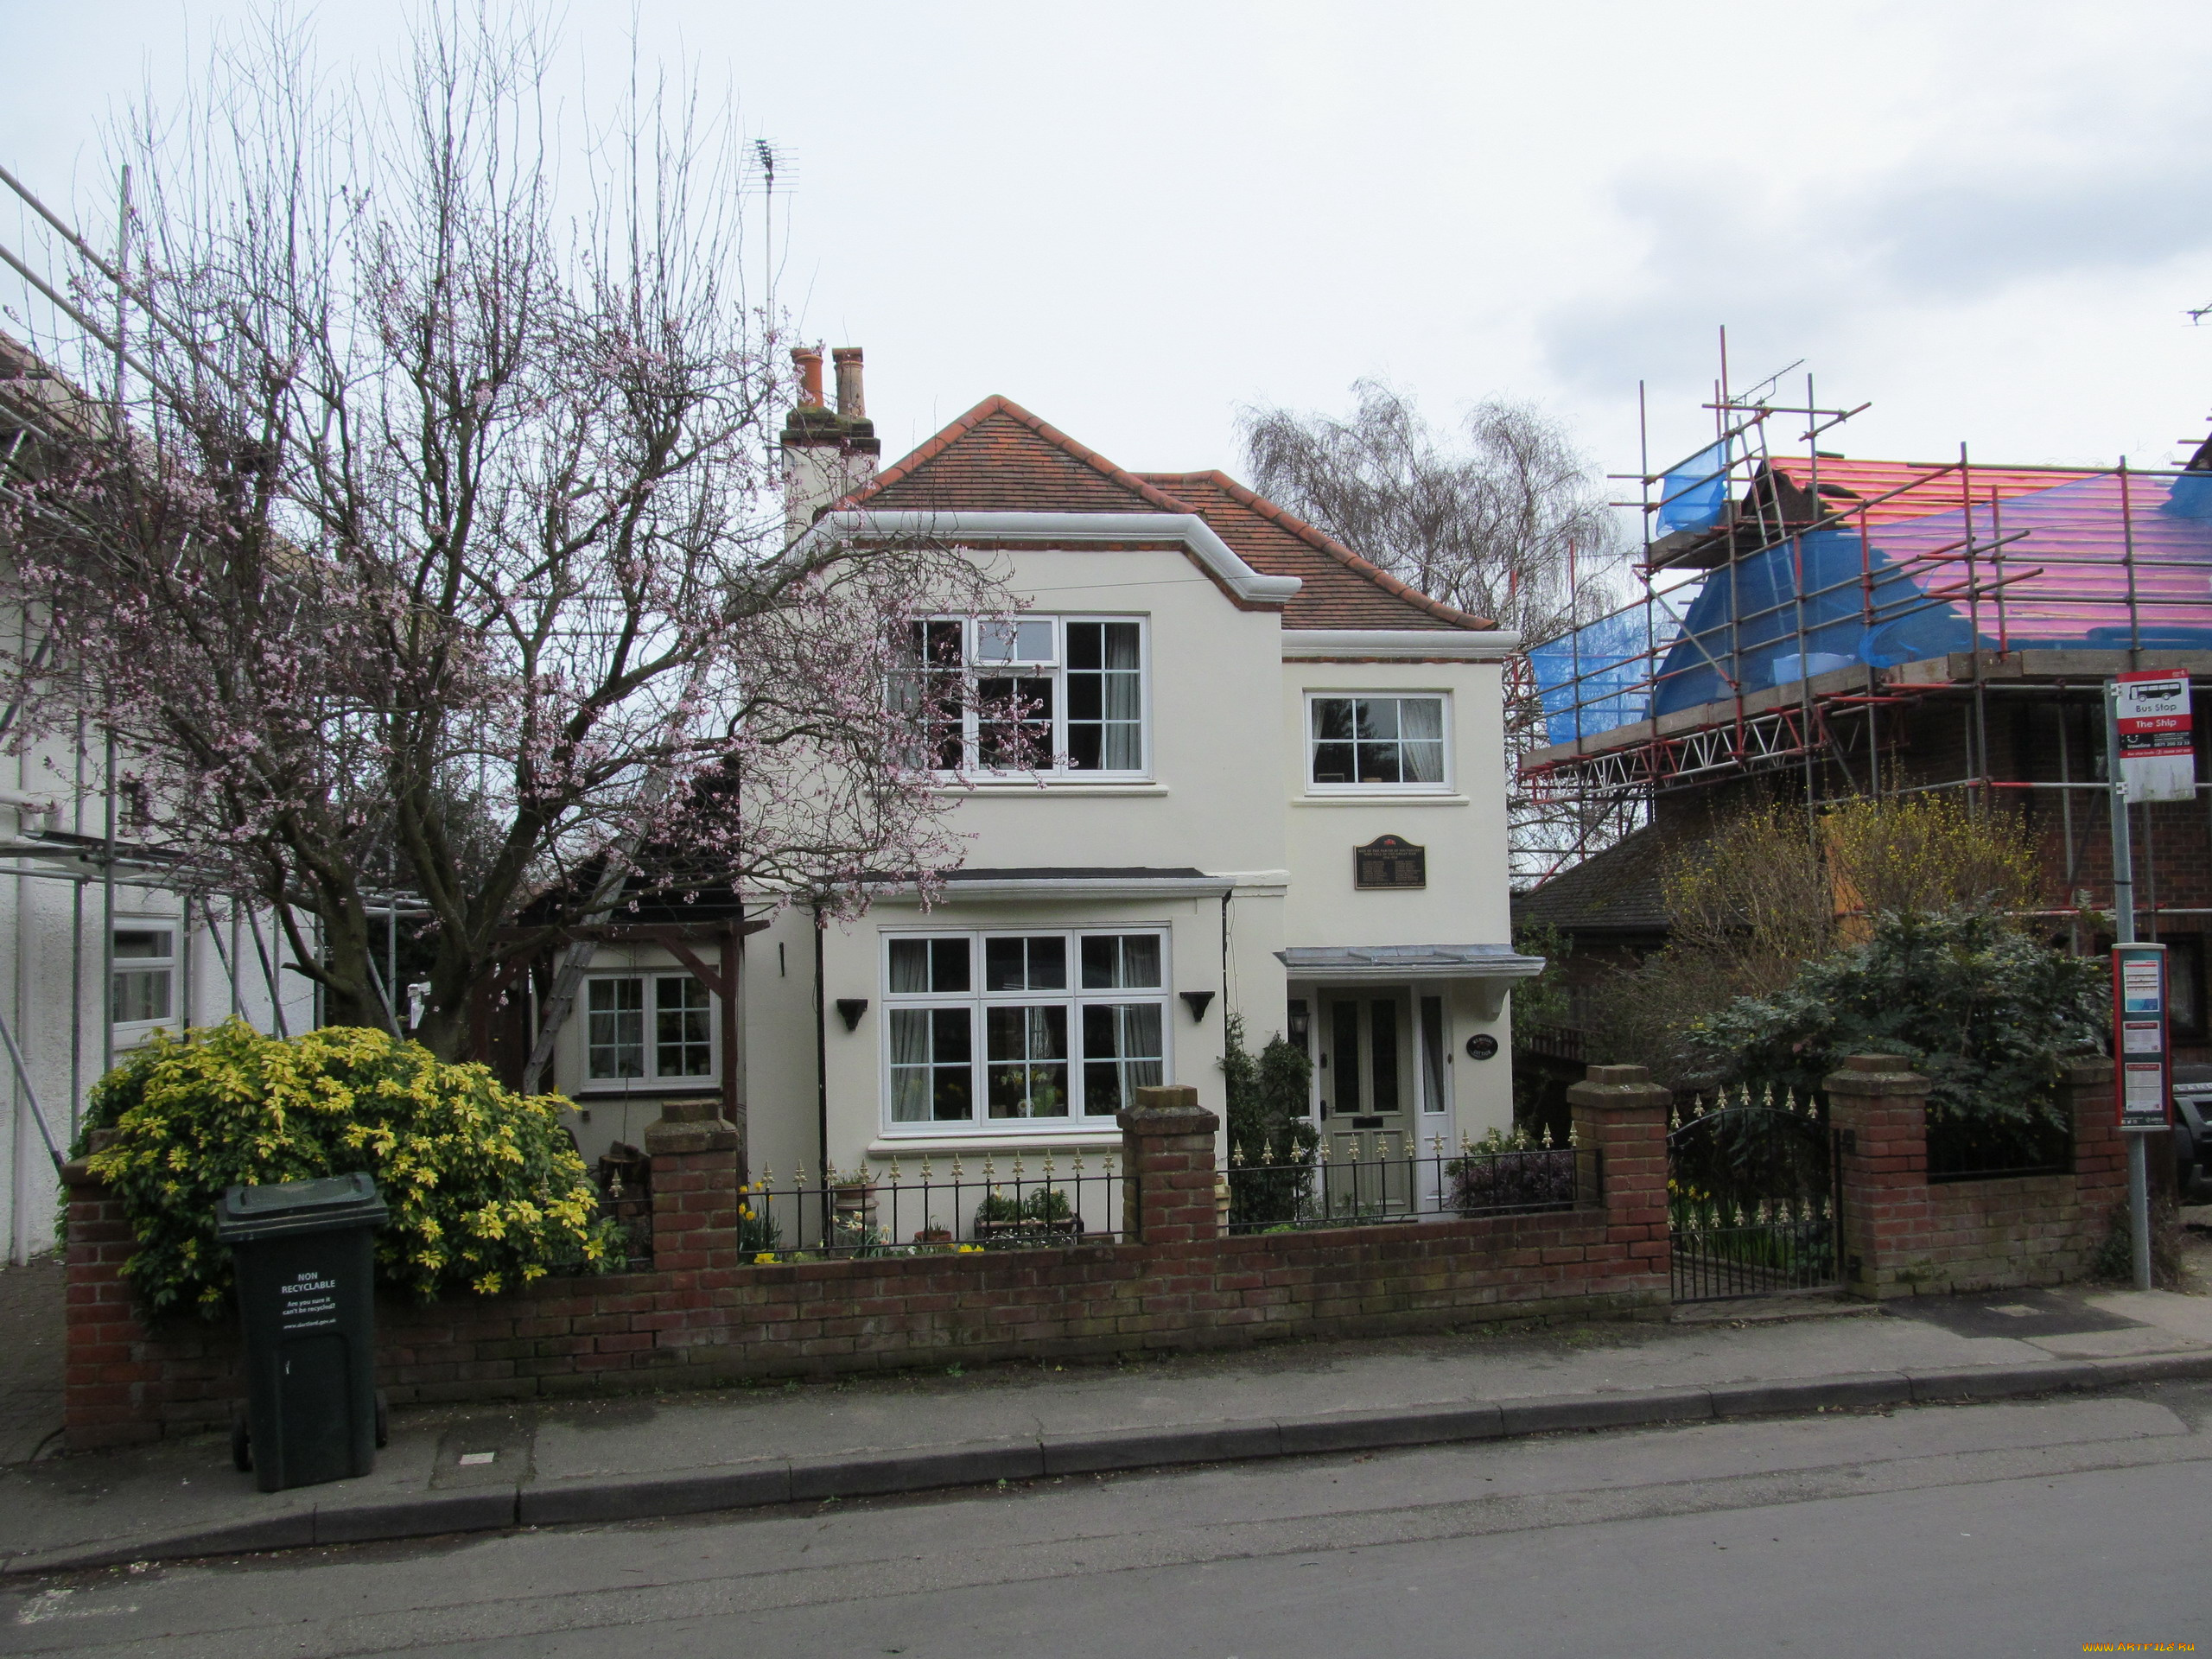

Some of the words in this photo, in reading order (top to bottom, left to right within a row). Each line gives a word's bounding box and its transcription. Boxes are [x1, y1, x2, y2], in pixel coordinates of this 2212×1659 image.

[2155, 703, 2177, 712] Stop
[2156, 719, 2177, 728] Ship
[298, 1272, 318, 1281] NON
[282, 1280, 335, 1294] RECYCLABLE
[308, 1303, 336, 1313] recycled?
